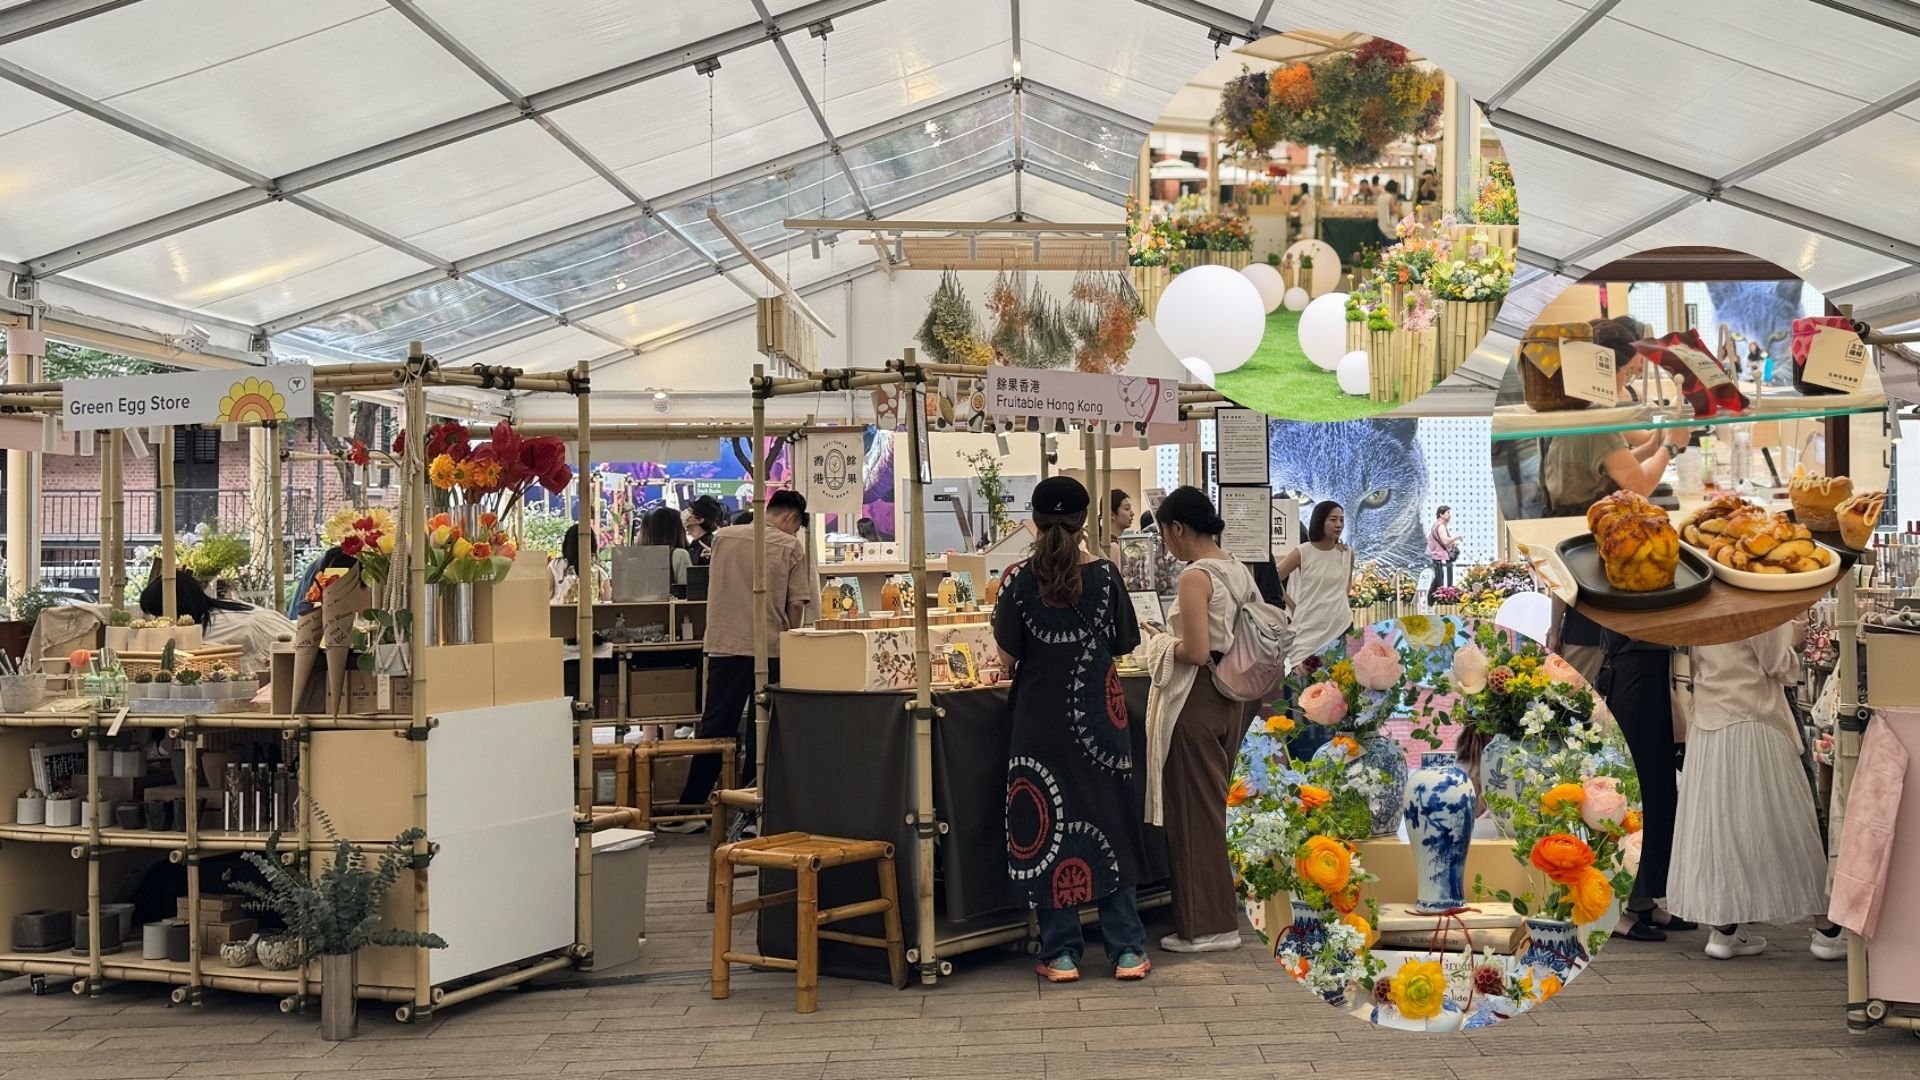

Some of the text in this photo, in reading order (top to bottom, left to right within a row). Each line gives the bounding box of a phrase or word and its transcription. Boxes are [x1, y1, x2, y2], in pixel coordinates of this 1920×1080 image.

[996, 377, 1041, 394] 餘果香港
[70, 395, 191, 416] Green Egg Store
[996, 394, 1103, 415] Fruitable Hong Kong
